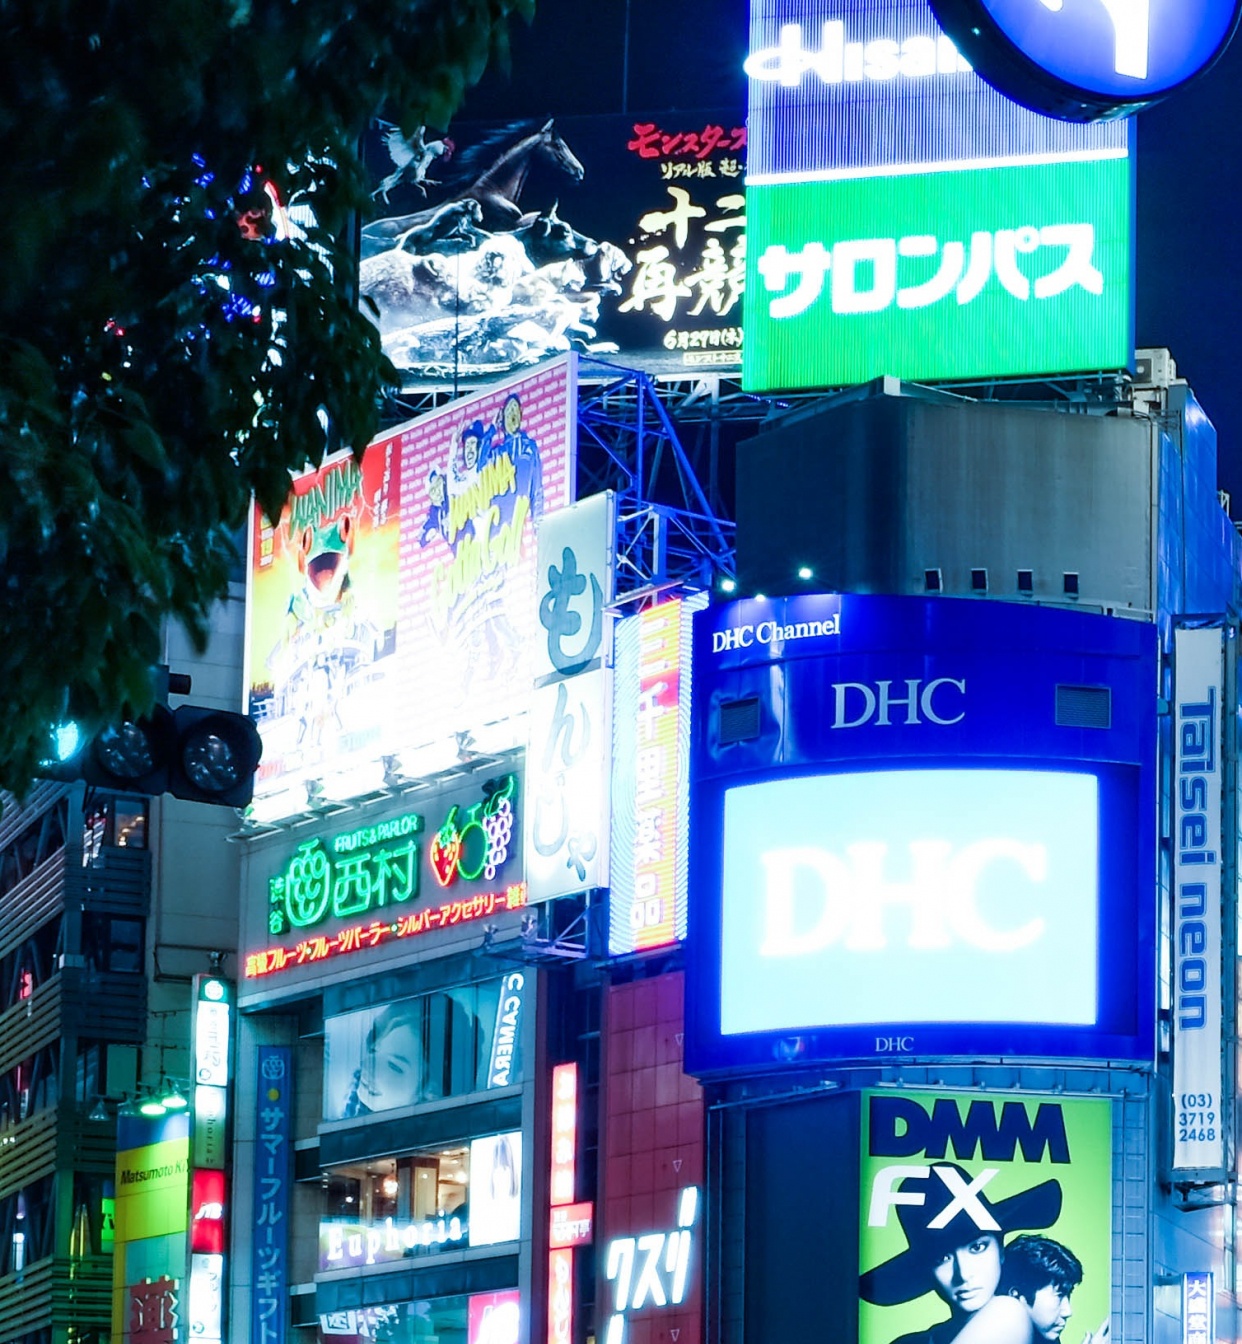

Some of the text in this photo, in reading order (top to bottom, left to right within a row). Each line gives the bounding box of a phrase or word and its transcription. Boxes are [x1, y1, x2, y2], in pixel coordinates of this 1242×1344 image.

[758, 223, 1103, 319] サロンパス
[712, 614, 841, 653] DHC Channel
[533, 546, 603, 882] もんじゃ
[830, 677, 965, 729] DHC
[332, 839, 418, 917] 西村
[1178, 685, 1217, 1031] Taisei neon
[758, 838, 1047, 958] DHC
[874, 1036, 914, 1053] DHC
[1178, 1112, 1215, 1127] 3719
[1181, 1093, 1213, 1109] (03)
[868, 1095, 1071, 1165] DMM
[1178, 1128, 1216, 1143] 2468
[120, 1165, 174, 1187] Matsumoto
[868, 1165, 1002, 1231] FX
[327, 1209, 462, 1265] Euphoria
